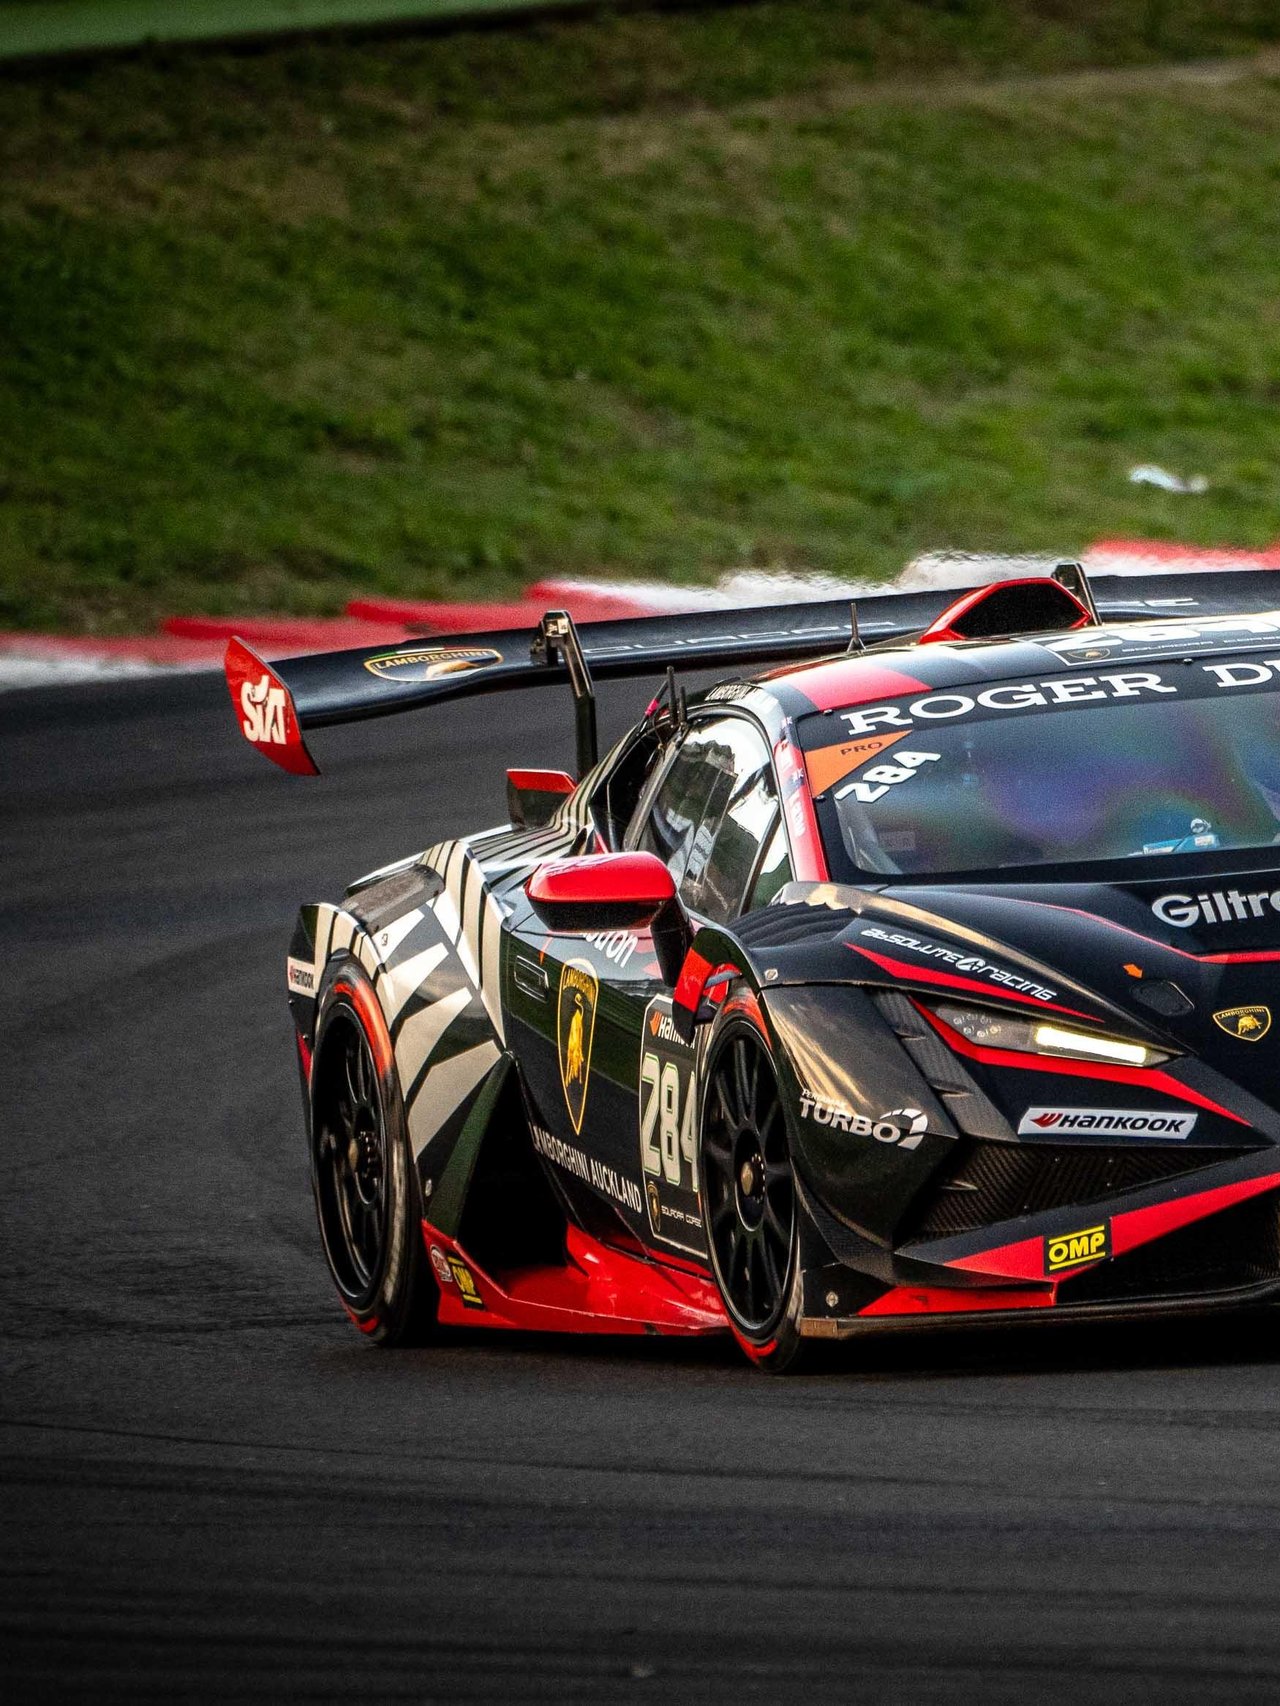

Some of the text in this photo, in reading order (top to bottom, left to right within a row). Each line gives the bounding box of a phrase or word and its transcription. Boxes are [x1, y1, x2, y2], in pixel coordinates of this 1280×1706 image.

[374, 651, 490, 670] LAMBORGHINI
[840, 673, 1177, 735] ROGER
[840, 741, 883, 755] PRO
[834, 751, 941, 804] 284
[1217, 1008, 1265, 1020] LAMBORGHINI
[641, 1052, 699, 1193] 284
[590, 1158, 642, 1214] AUCKLAND
[1049, 1232, 1105, 1264] OMP
